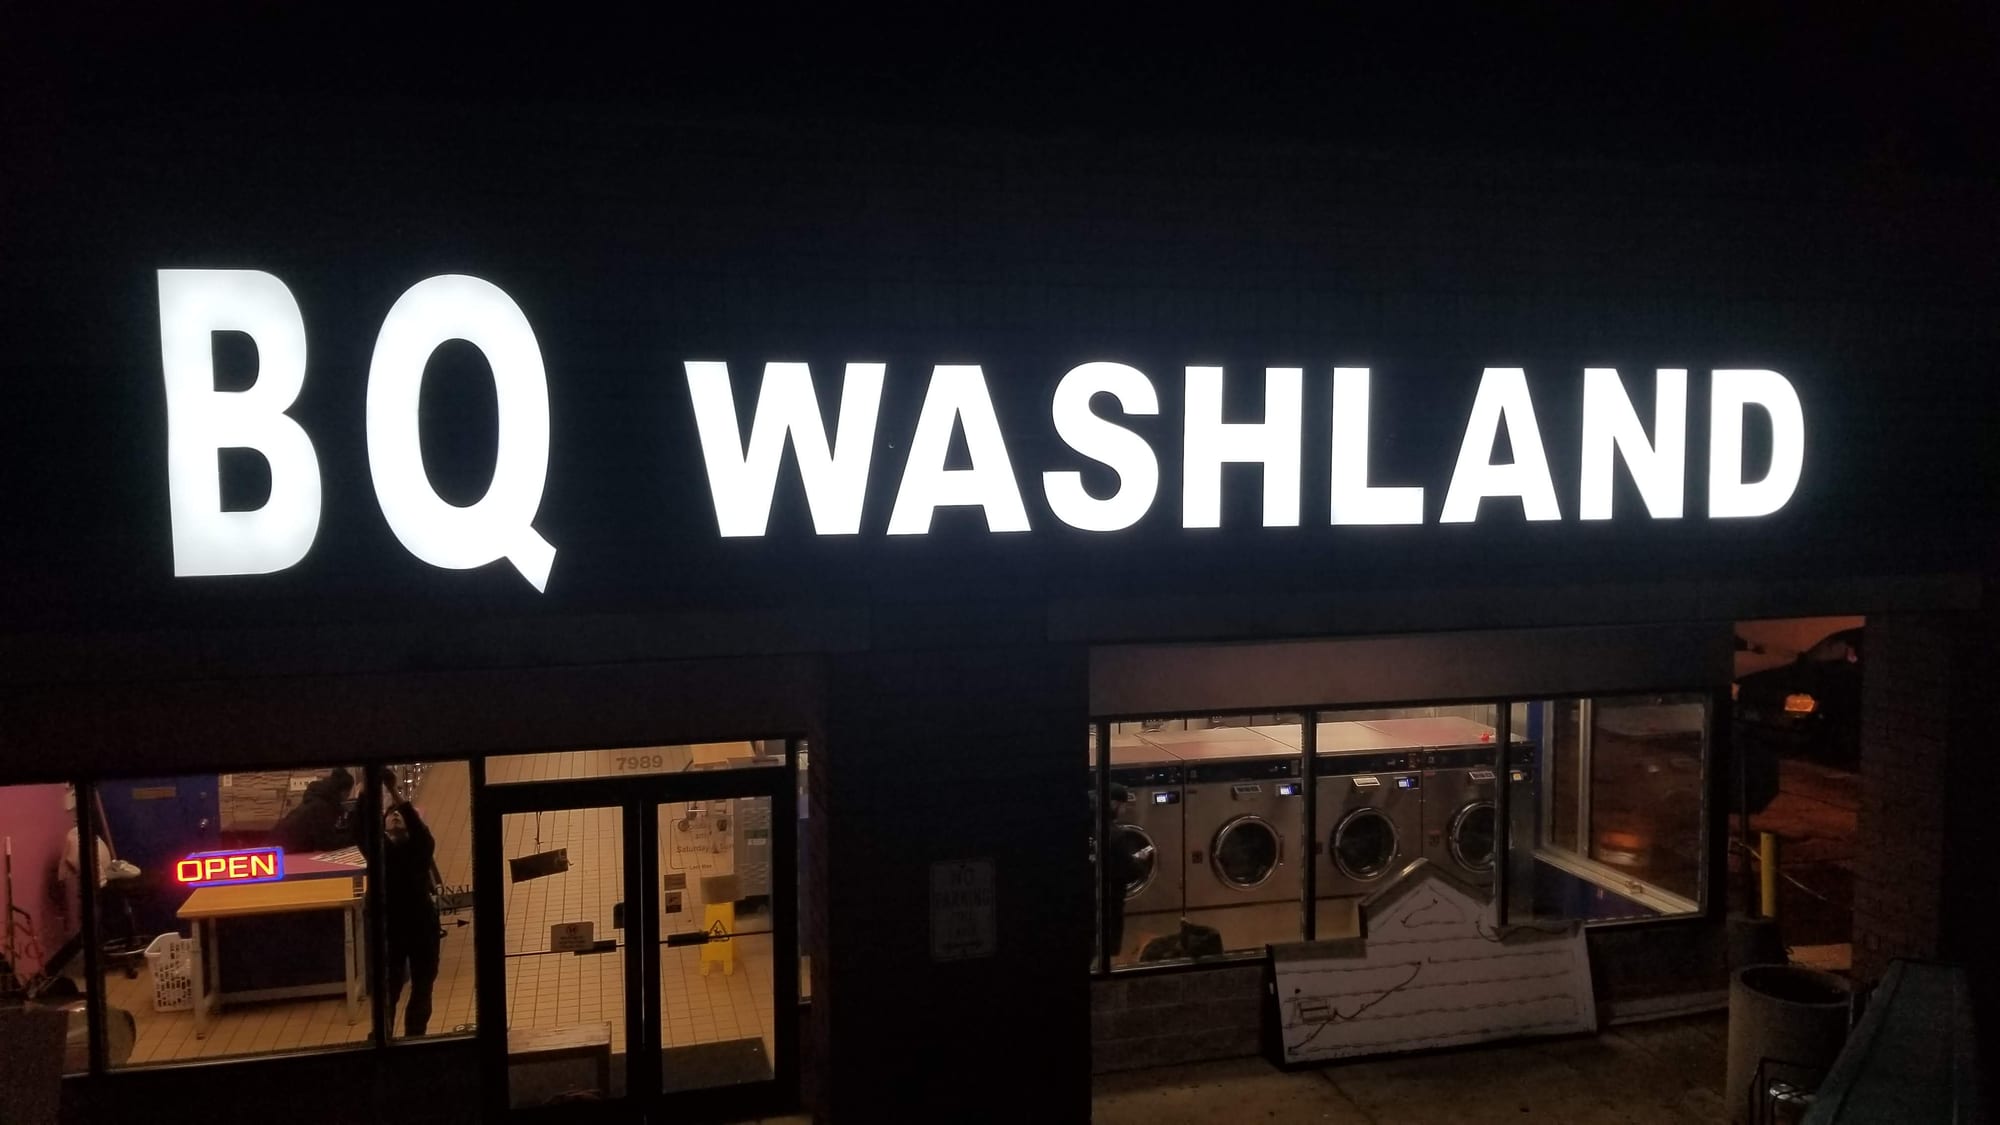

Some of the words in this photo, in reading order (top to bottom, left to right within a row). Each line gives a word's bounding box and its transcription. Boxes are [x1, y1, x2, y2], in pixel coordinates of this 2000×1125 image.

[157, 268, 557, 594] BQ
[684, 360, 1806, 538] WASHLAND
[615, 755, 663, 770] 7989
[176, 854, 275, 882] OPEN
